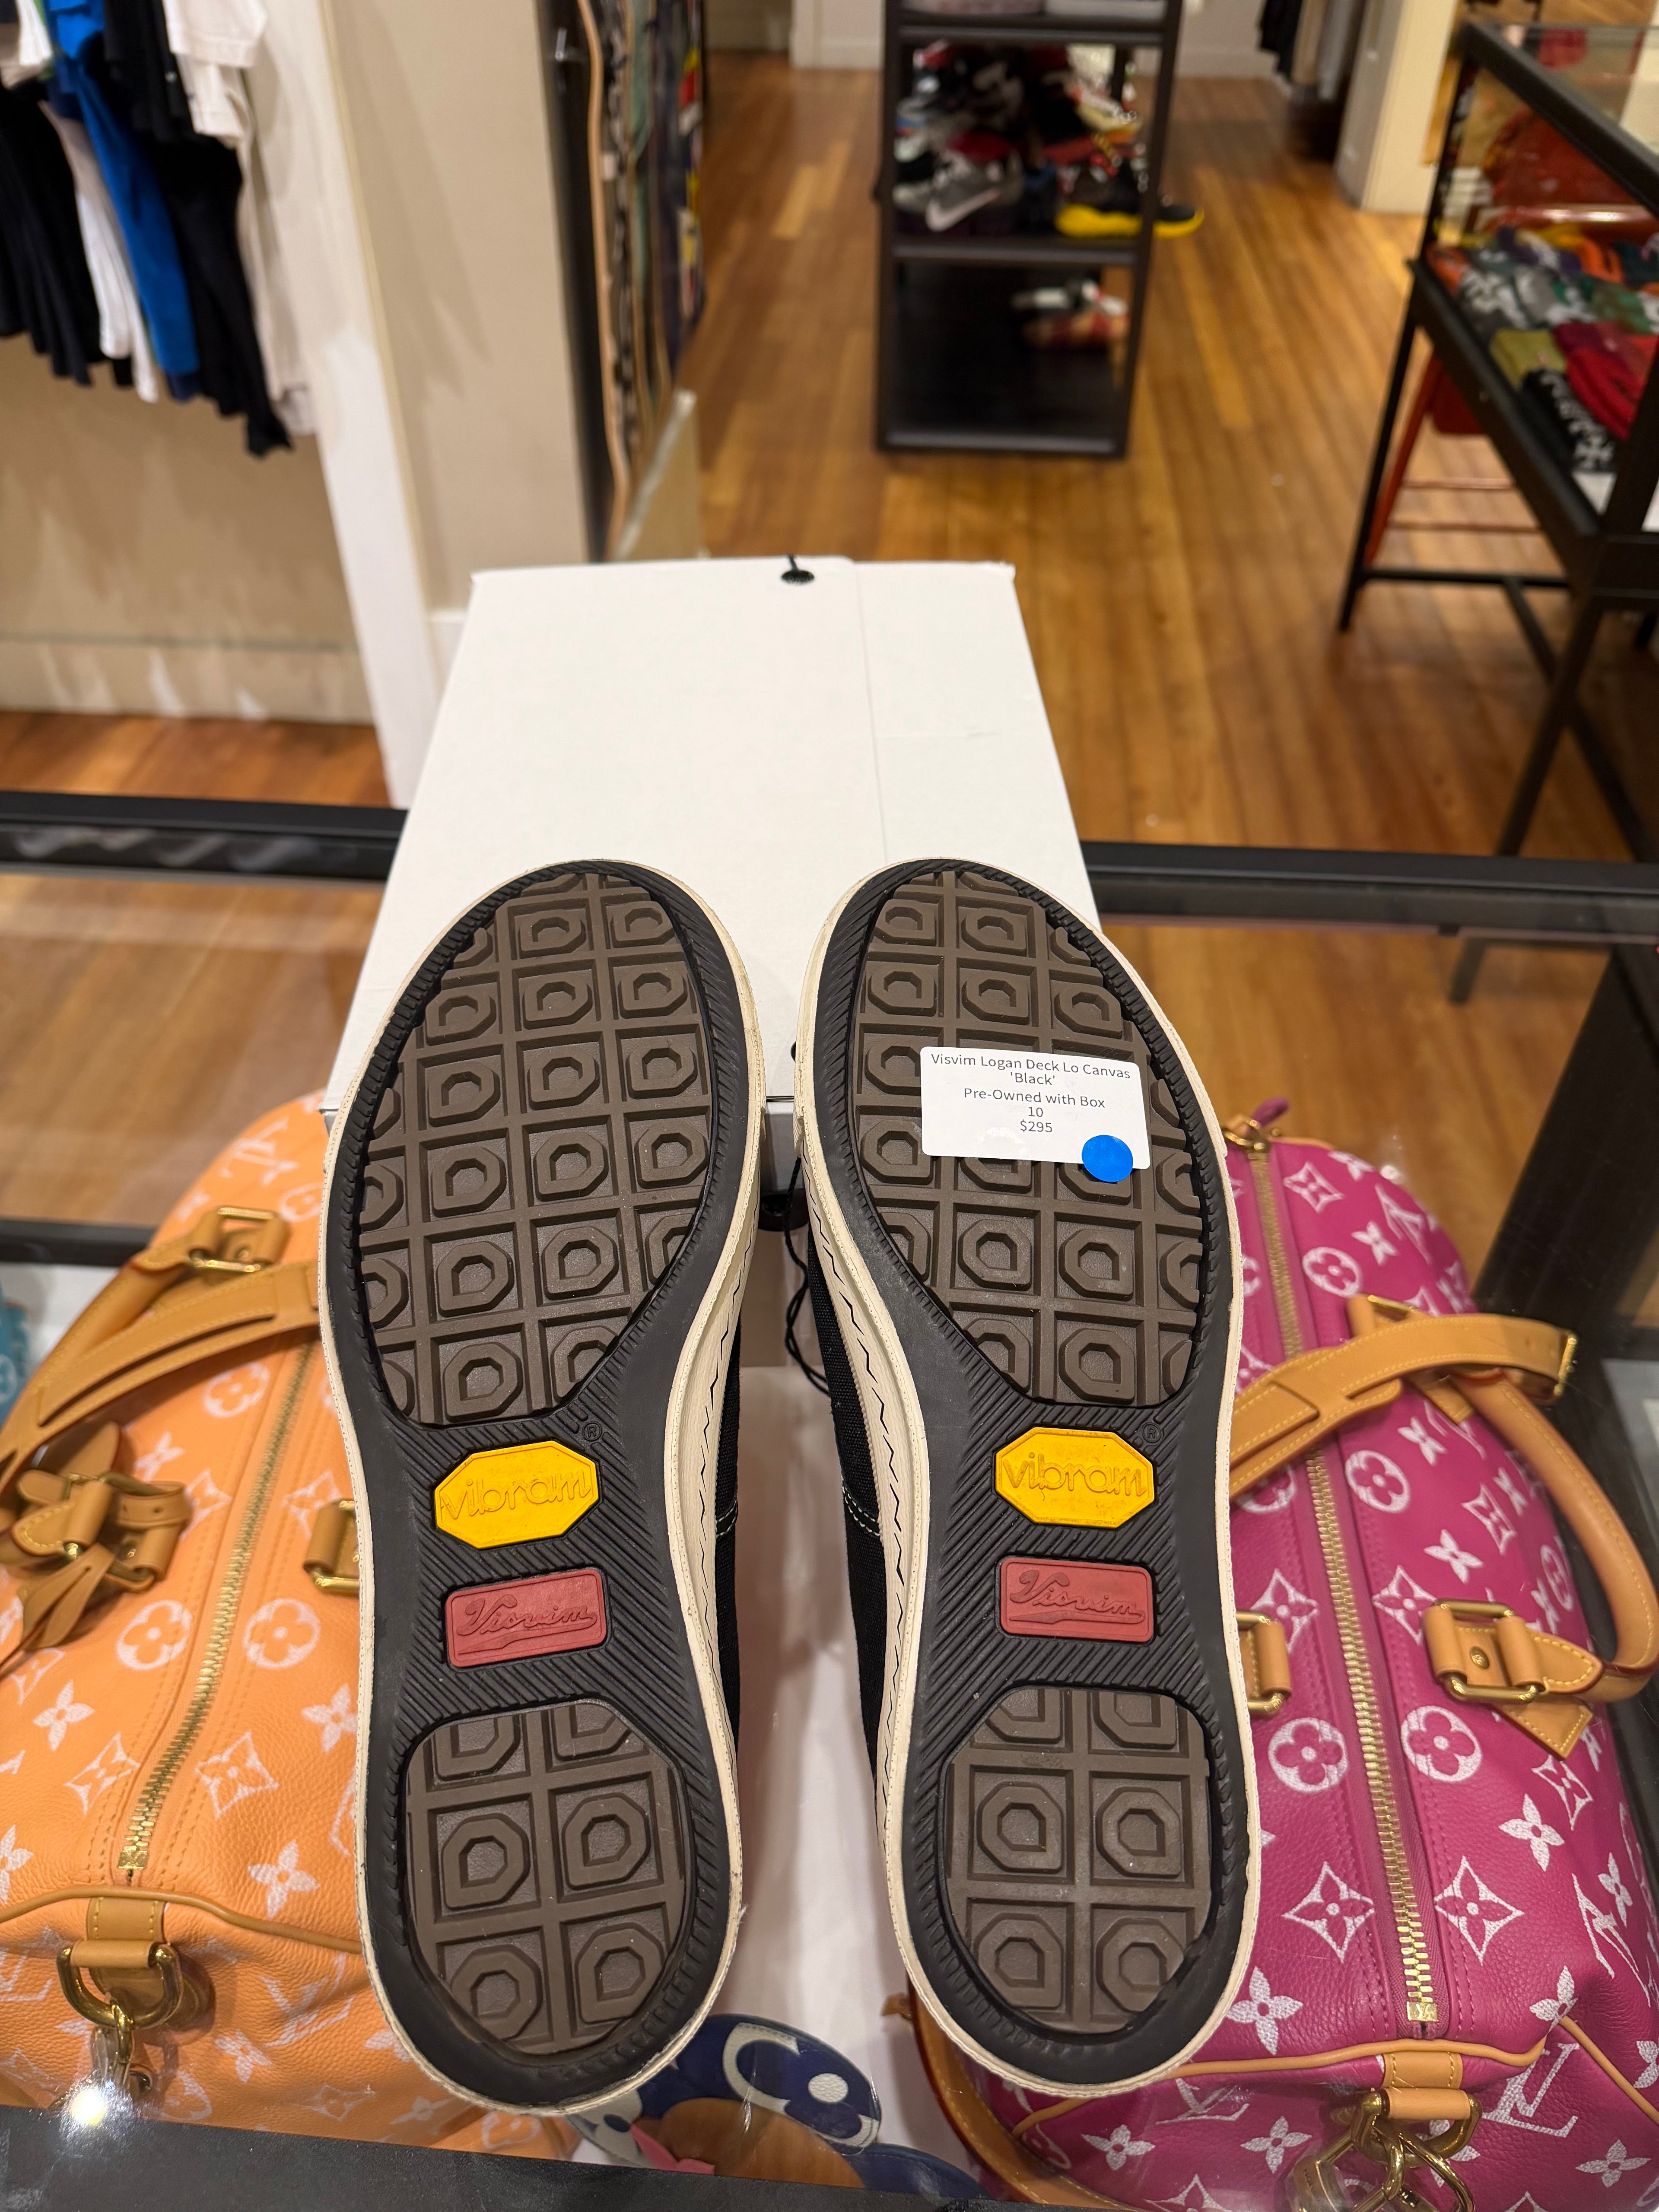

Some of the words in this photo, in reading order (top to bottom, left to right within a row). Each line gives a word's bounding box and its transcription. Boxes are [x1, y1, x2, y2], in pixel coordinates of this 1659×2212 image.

[931, 1054, 976, 1065] Visvim
[981, 1056, 1021, 1071] Logan
[1026, 1059, 1060, 1071] Deck
[1063, 1062, 1078, 1073] Lo
[1083, 1064, 1131, 1079] Canvas
[1011, 1072, 1055, 1085] 'Black'
[964, 1088, 1041, 1103] Pre-Owned
[1045, 1093, 1075, 1105] with
[1080, 1096, 1105, 1108] Box
[1028, 1106, 1043, 1117] 10
[1020, 1119, 1053, 1133] $295
[1002, 1451, 1148, 1497] vibram
[441, 1468, 592, 1519] vibram
